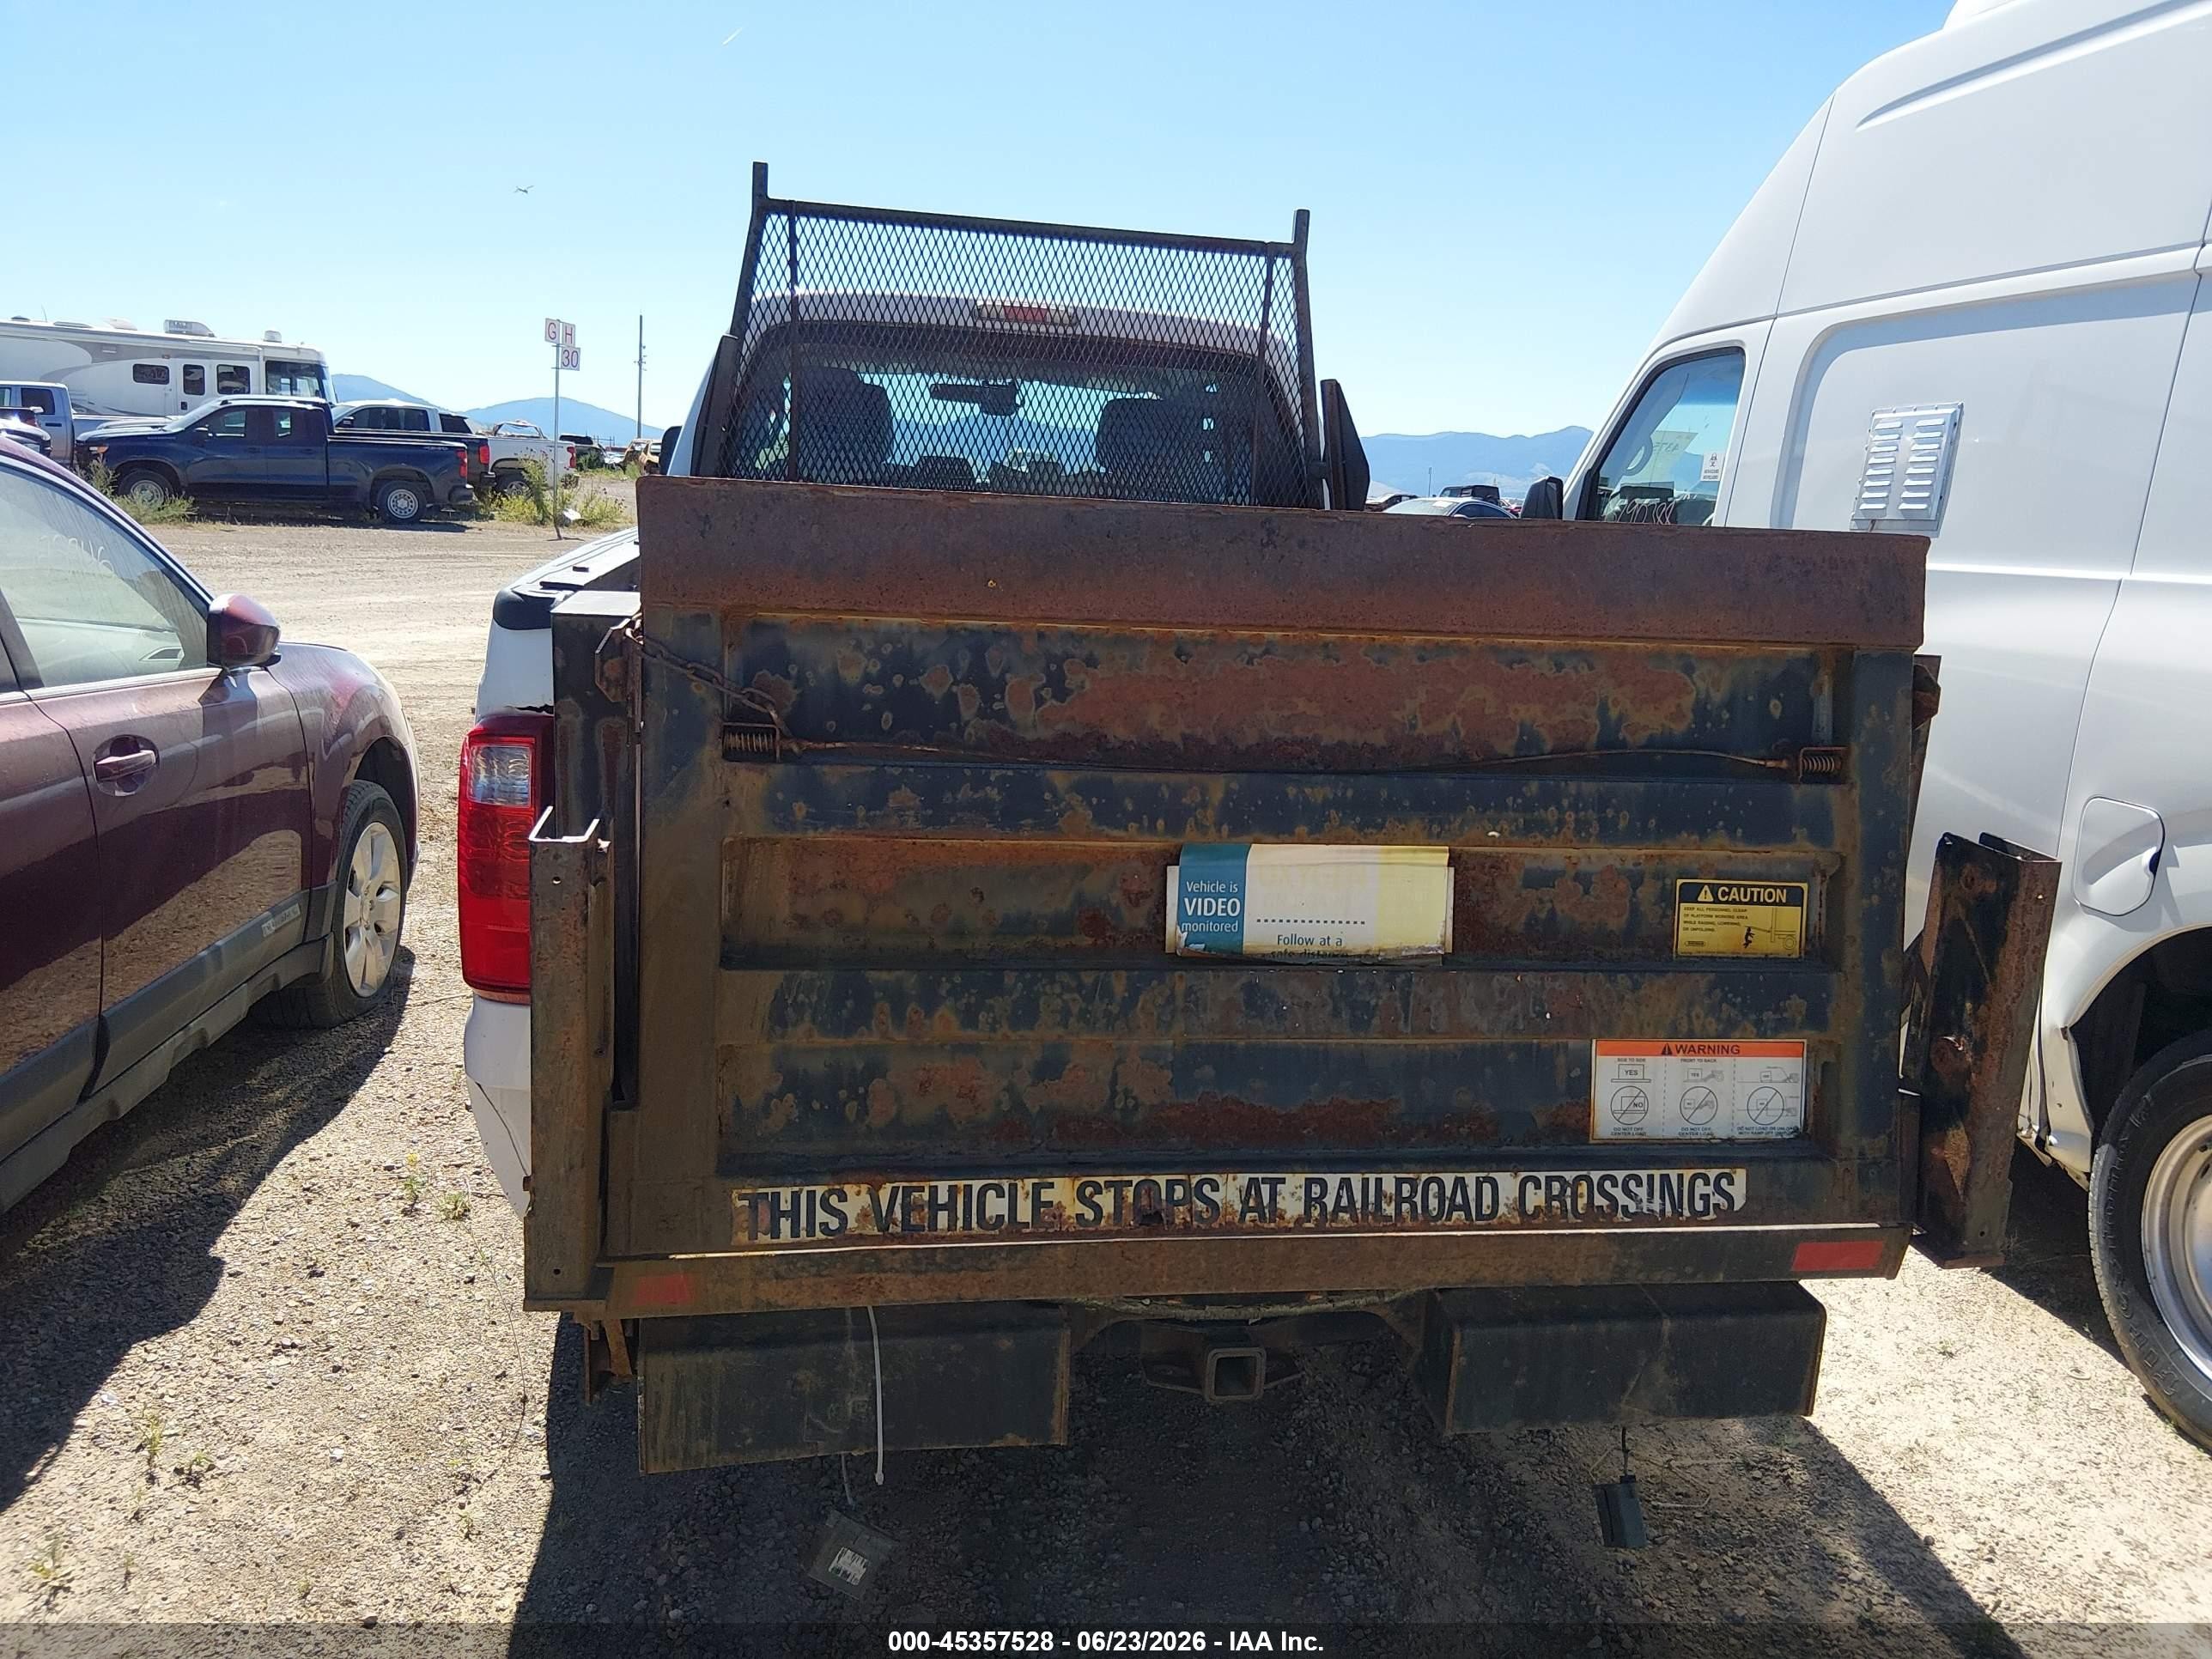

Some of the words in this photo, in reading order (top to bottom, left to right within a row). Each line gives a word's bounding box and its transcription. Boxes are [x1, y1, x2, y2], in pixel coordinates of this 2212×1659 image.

[548, 322, 556, 340] G
[565, 325, 573, 344] H
[562, 349, 579, 368] 30
[1186, 880, 1226, 894] Vehicle
[1230, 882, 1238, 893] is
[1718, 887, 1787, 903] CAUTION
[1183, 897, 1241, 917] VIDEO
[1182, 921, 1238, 933] monitored
[1277, 933, 1315, 945] Follow
[1319, 935, 1330, 946] at
[1335, 937, 1343, 946] a
[1675, 1044, 1741, 1055] WARNING
[737, 1186, 848, 1240] THIS
[866, 1181, 1054, 1233] VEHICLE
[1075, 1176, 1221, 1228] STOPS
[1238, 1176, 1285, 1224] AT
[1304, 1176, 1498, 1223] RAILROAD
[1518, 1172, 1735, 1220] CROSSINGS
